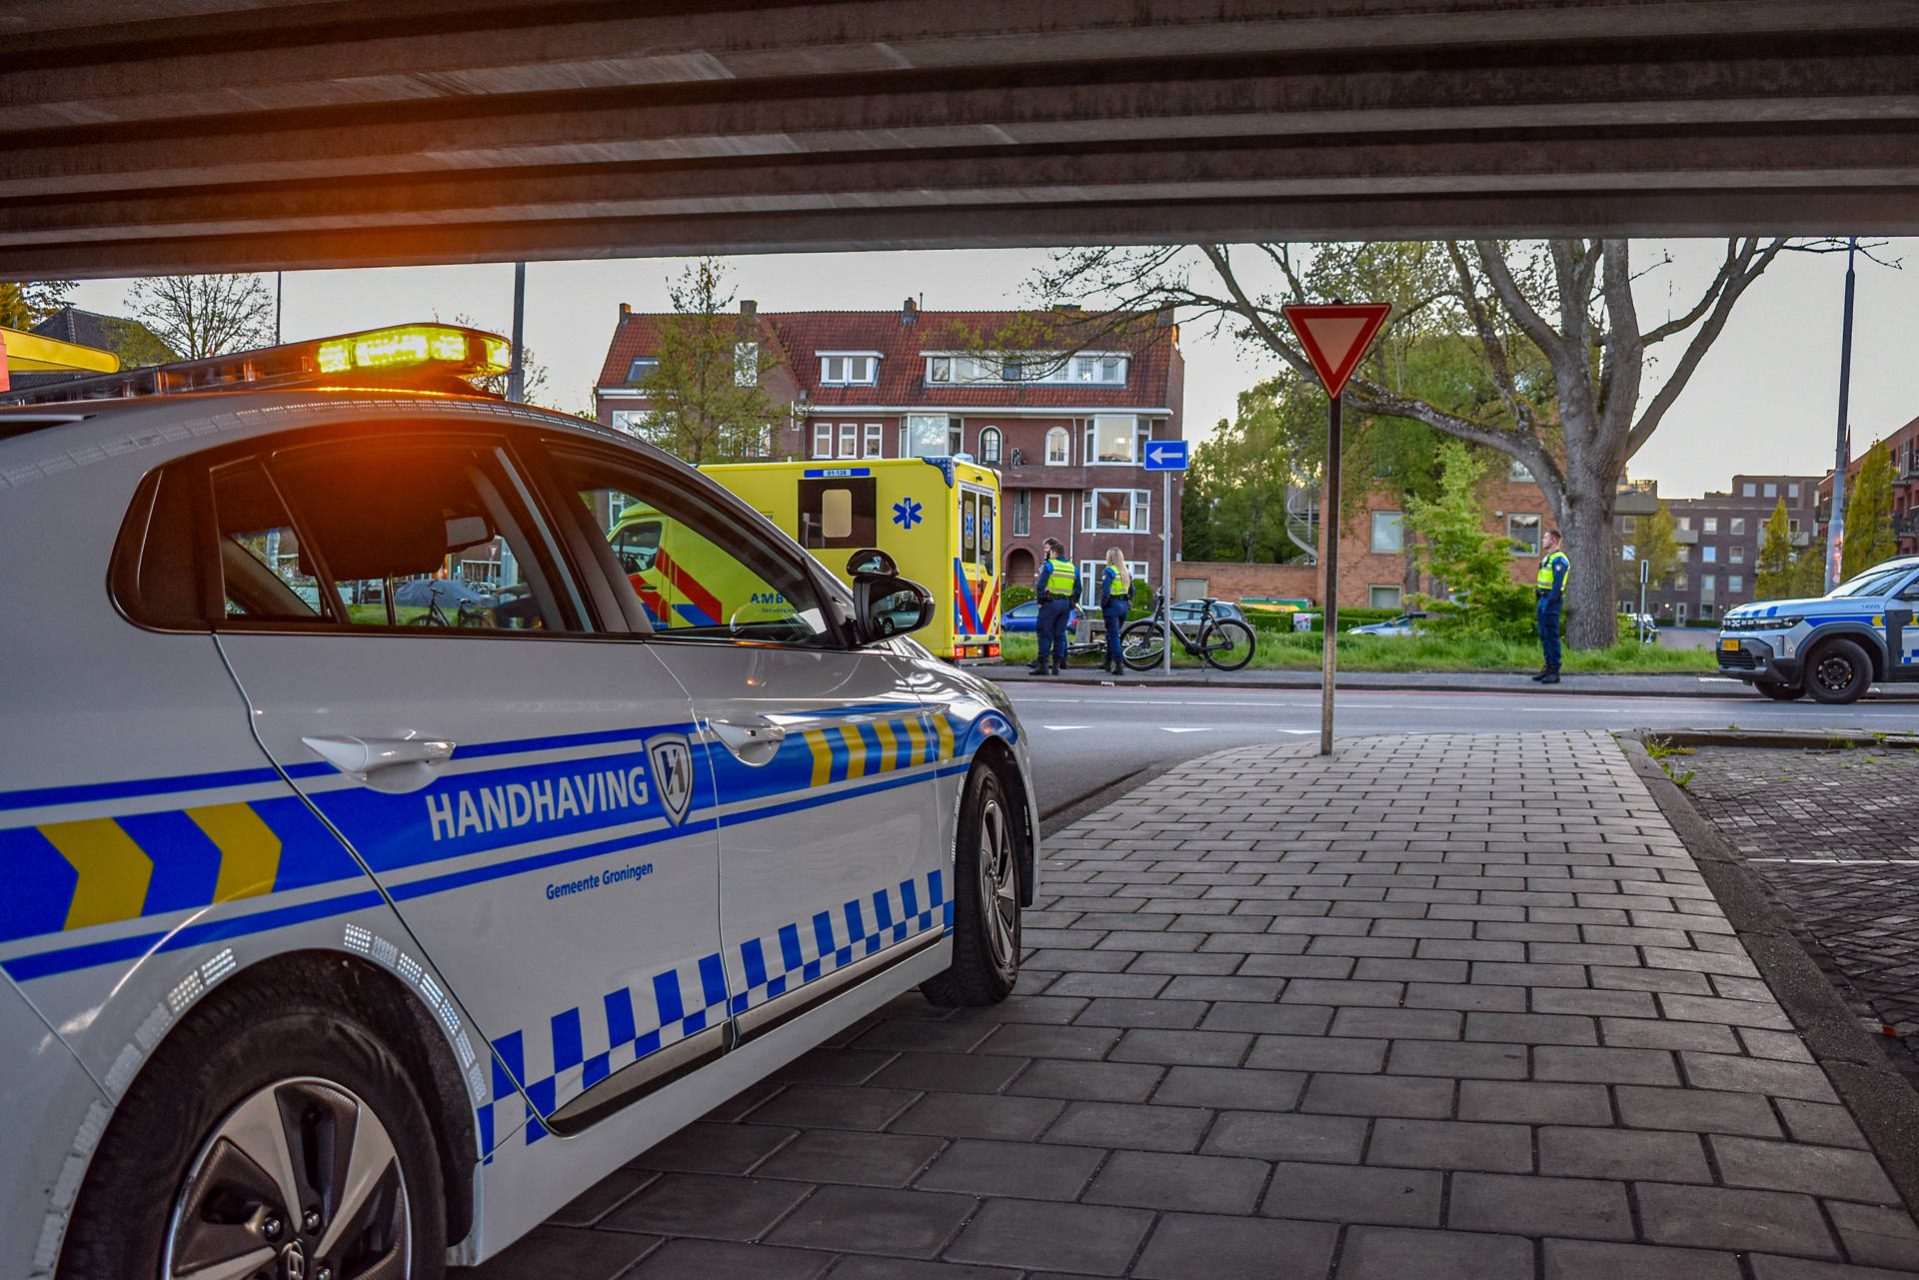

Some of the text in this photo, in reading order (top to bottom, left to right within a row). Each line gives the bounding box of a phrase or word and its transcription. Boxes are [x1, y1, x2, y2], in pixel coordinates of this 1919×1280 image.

[425, 767, 649, 841] HANDHAVING
[546, 863, 653, 900] Gemeente Groningen
